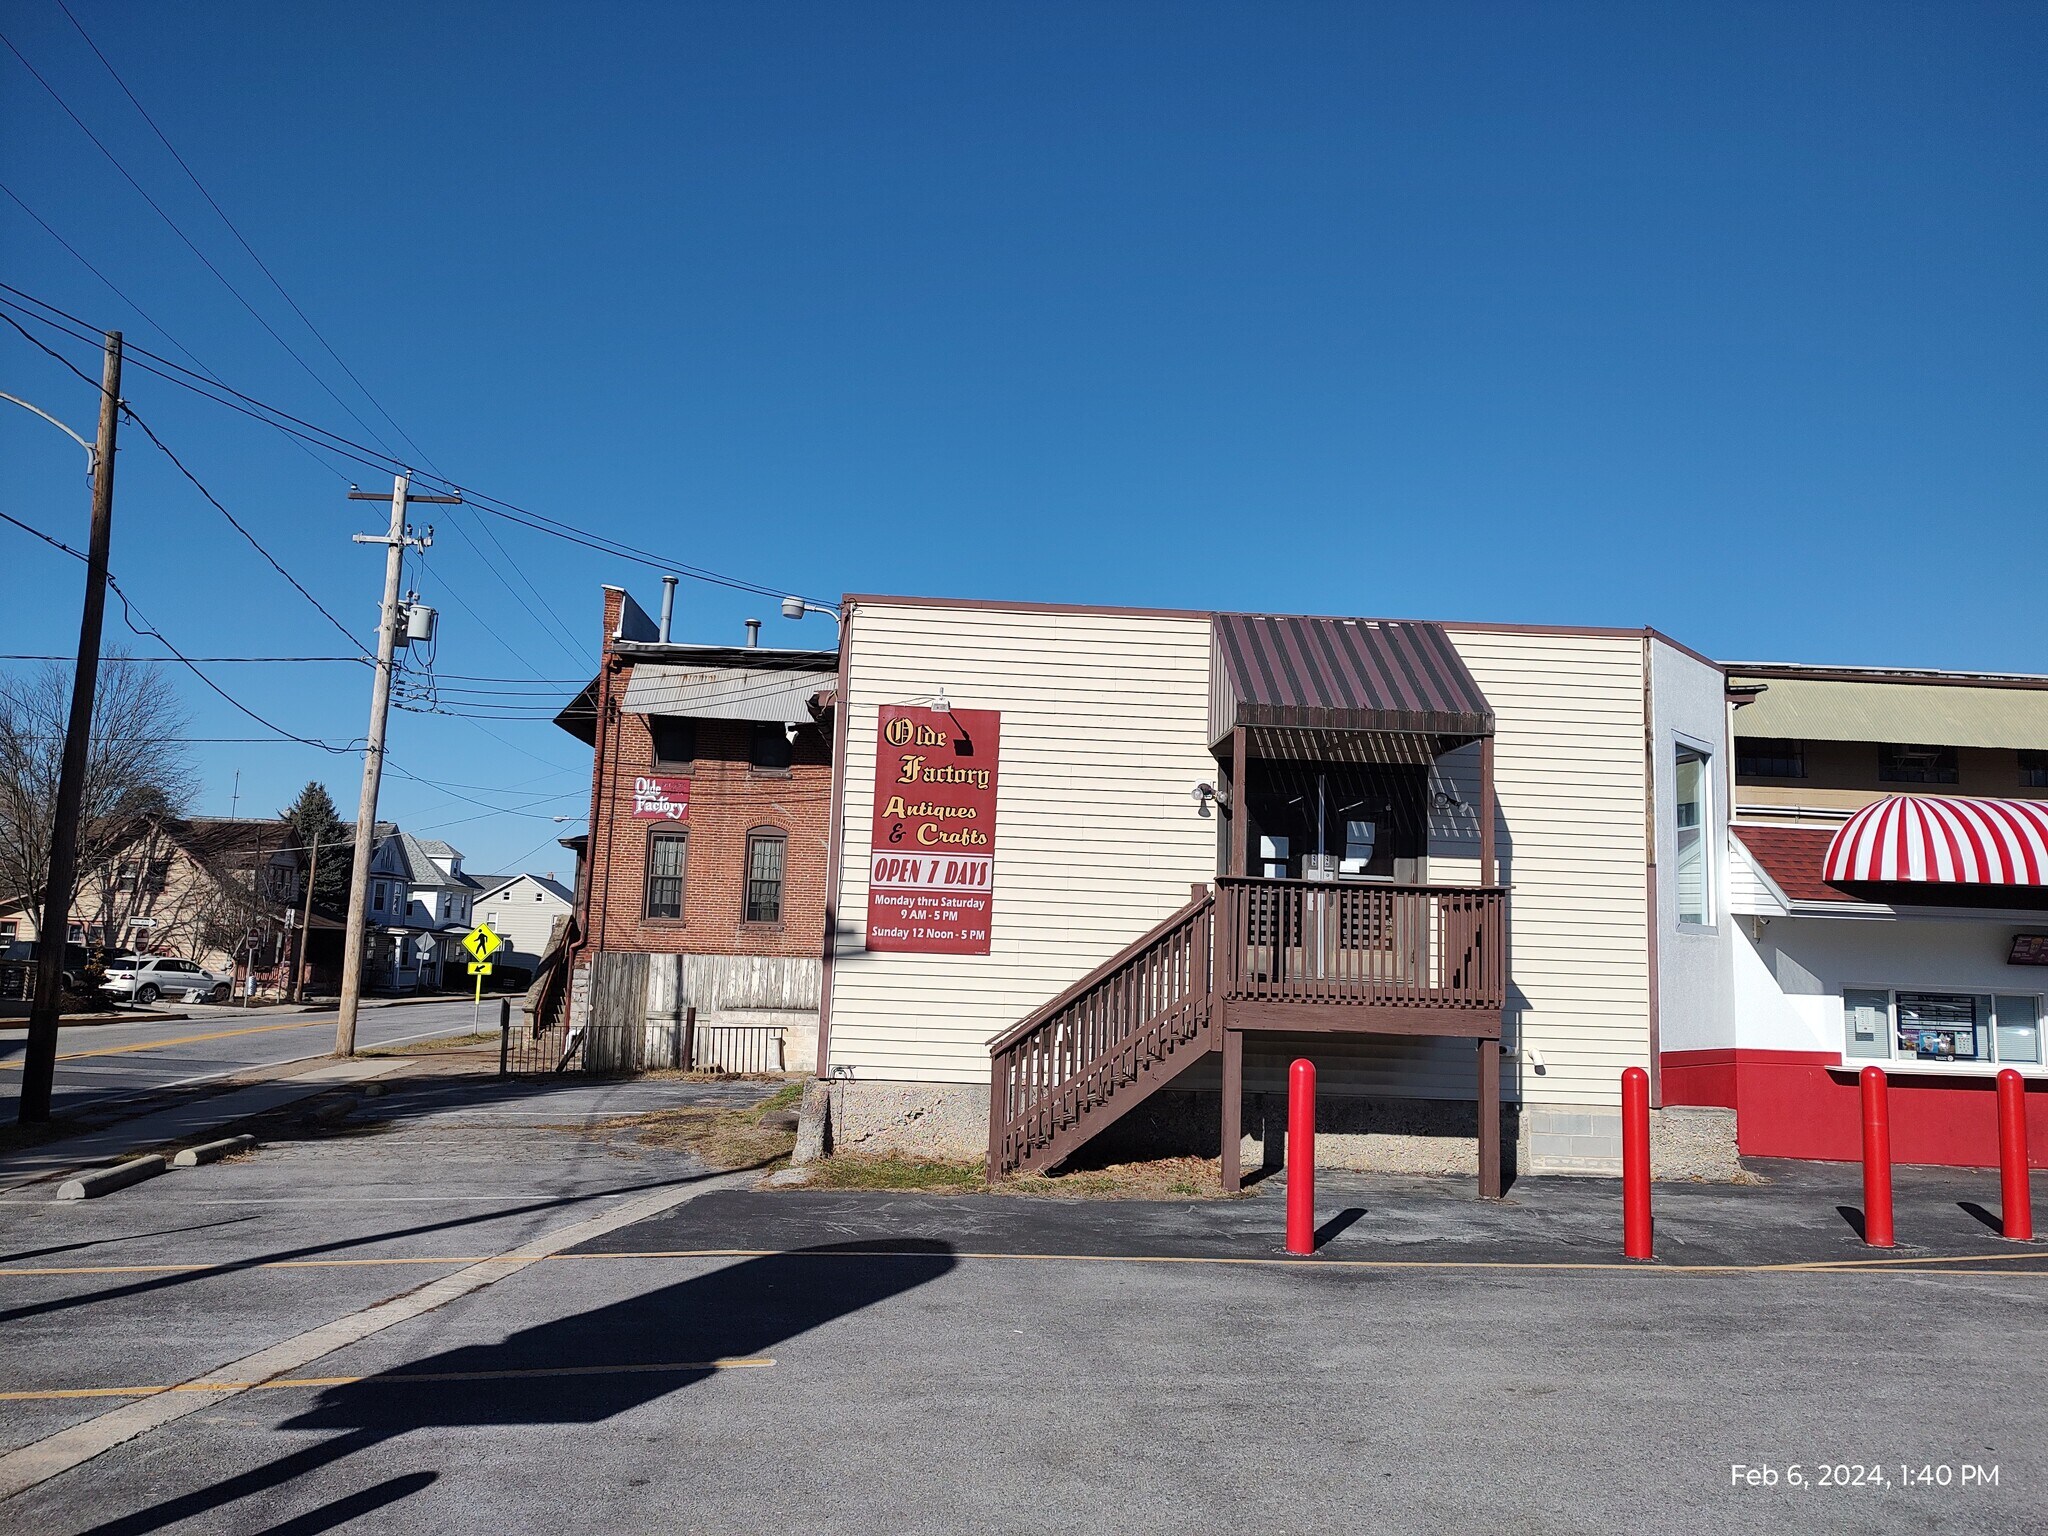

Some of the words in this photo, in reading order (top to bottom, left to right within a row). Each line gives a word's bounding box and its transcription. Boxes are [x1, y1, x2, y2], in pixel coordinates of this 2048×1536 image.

[884, 716, 948, 747] Olde
[896, 754, 991, 790] Factory
[635, 777, 661, 794] Olde
[633, 794, 687, 819] Factory
[881, 795, 977, 821] Antiques
[889, 823, 906, 843] &
[916, 822, 988, 846] Crafts
[874, 858, 922, 882] OPEN
[927, 861, 940, 883] 7
[944, 861, 988, 886] DAYS
[874, 894, 915, 908] Monday
[917, 896, 938, 907] thru
[941, 896, 985, 911] Saturday
[900, 909, 907, 919] 9
[909, 910, 926, 920] AM
[934, 911, 940, 920] 5
[942, 911, 958, 921] PM
[872, 926, 909, 940] Sunday
[912, 928, 924, 938] 12
[926, 929, 953, 939] Noon
[961, 930, 967, 940] 5
[969, 930, 985, 940] PM
